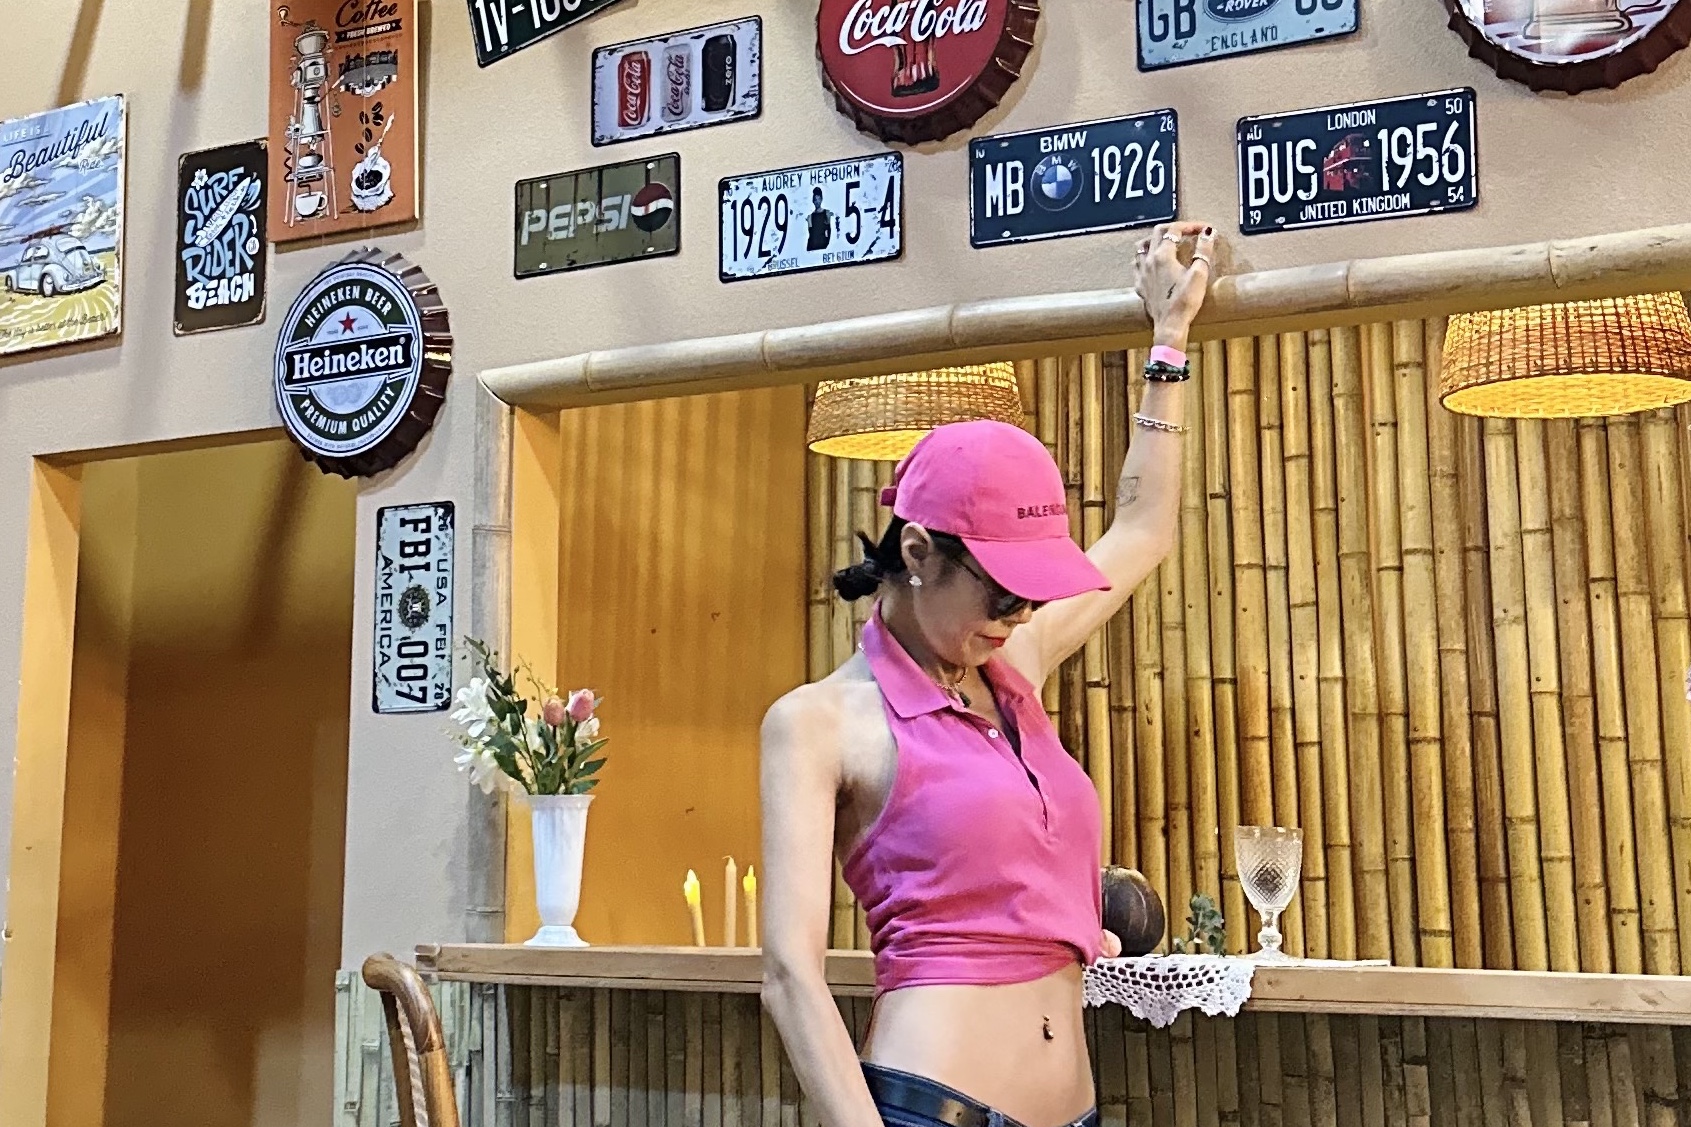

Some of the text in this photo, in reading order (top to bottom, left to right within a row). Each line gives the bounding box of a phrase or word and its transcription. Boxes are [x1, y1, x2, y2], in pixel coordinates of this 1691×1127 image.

[1149, 0, 1197, 43] GB
[1211, 26, 1278, 51] ENGLAND
[1327, 109, 1376, 131] LONDON
[1445, 98, 1463, 115] 50
[4, 112, 109, 183] Beautiful
[1040, 131, 1087, 153] BMW
[1248, 120, 1465, 207] BUS 1956
[762, 163, 860, 192] AUDREY HEPBURN
[985, 140, 1165, 218] MB 1926
[1447, 186, 1464, 203] 54
[184, 166, 245, 244] SURF
[521, 194, 631, 246] PEPSI
[731, 175, 896, 262] 1929 5-4
[1300, 193, 1411, 221] UNITED KINGDOM
[186, 272, 255, 310] BEACH
[304, 286, 392, 328] HEINEKEN BEER
[292, 343, 405, 380] Heineken
[300, 386, 395, 435] PREMIUM QUALITY
[379, 555, 394, 667] AMERICA
[395, 515, 432, 703] FBI 007
[435, 558, 448, 659] USA FBI
